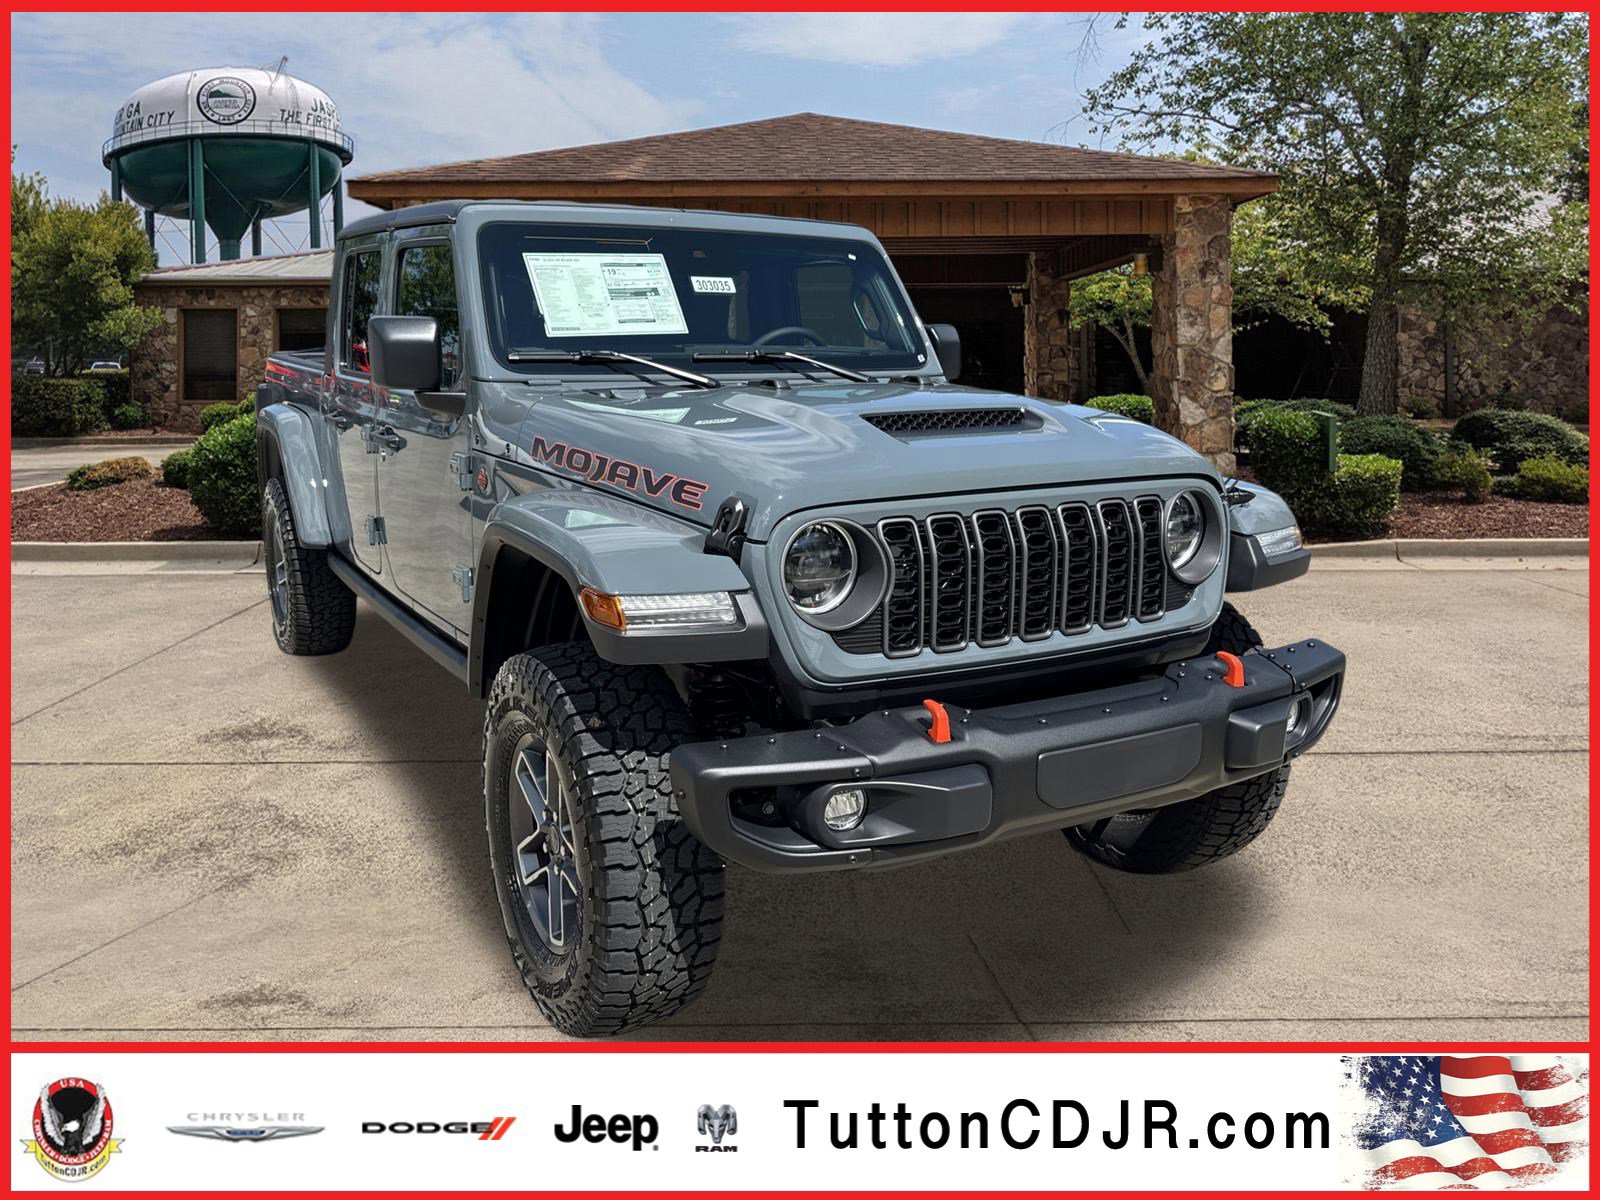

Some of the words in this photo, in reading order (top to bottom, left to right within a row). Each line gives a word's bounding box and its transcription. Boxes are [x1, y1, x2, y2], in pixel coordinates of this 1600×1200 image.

[126, 101, 140, 119] GA
[146, 110, 176, 128] CITY
[280, 109, 303, 124] THE
[696, 279, 732, 292] 303035
[531, 435, 709, 511] MOJAVE
